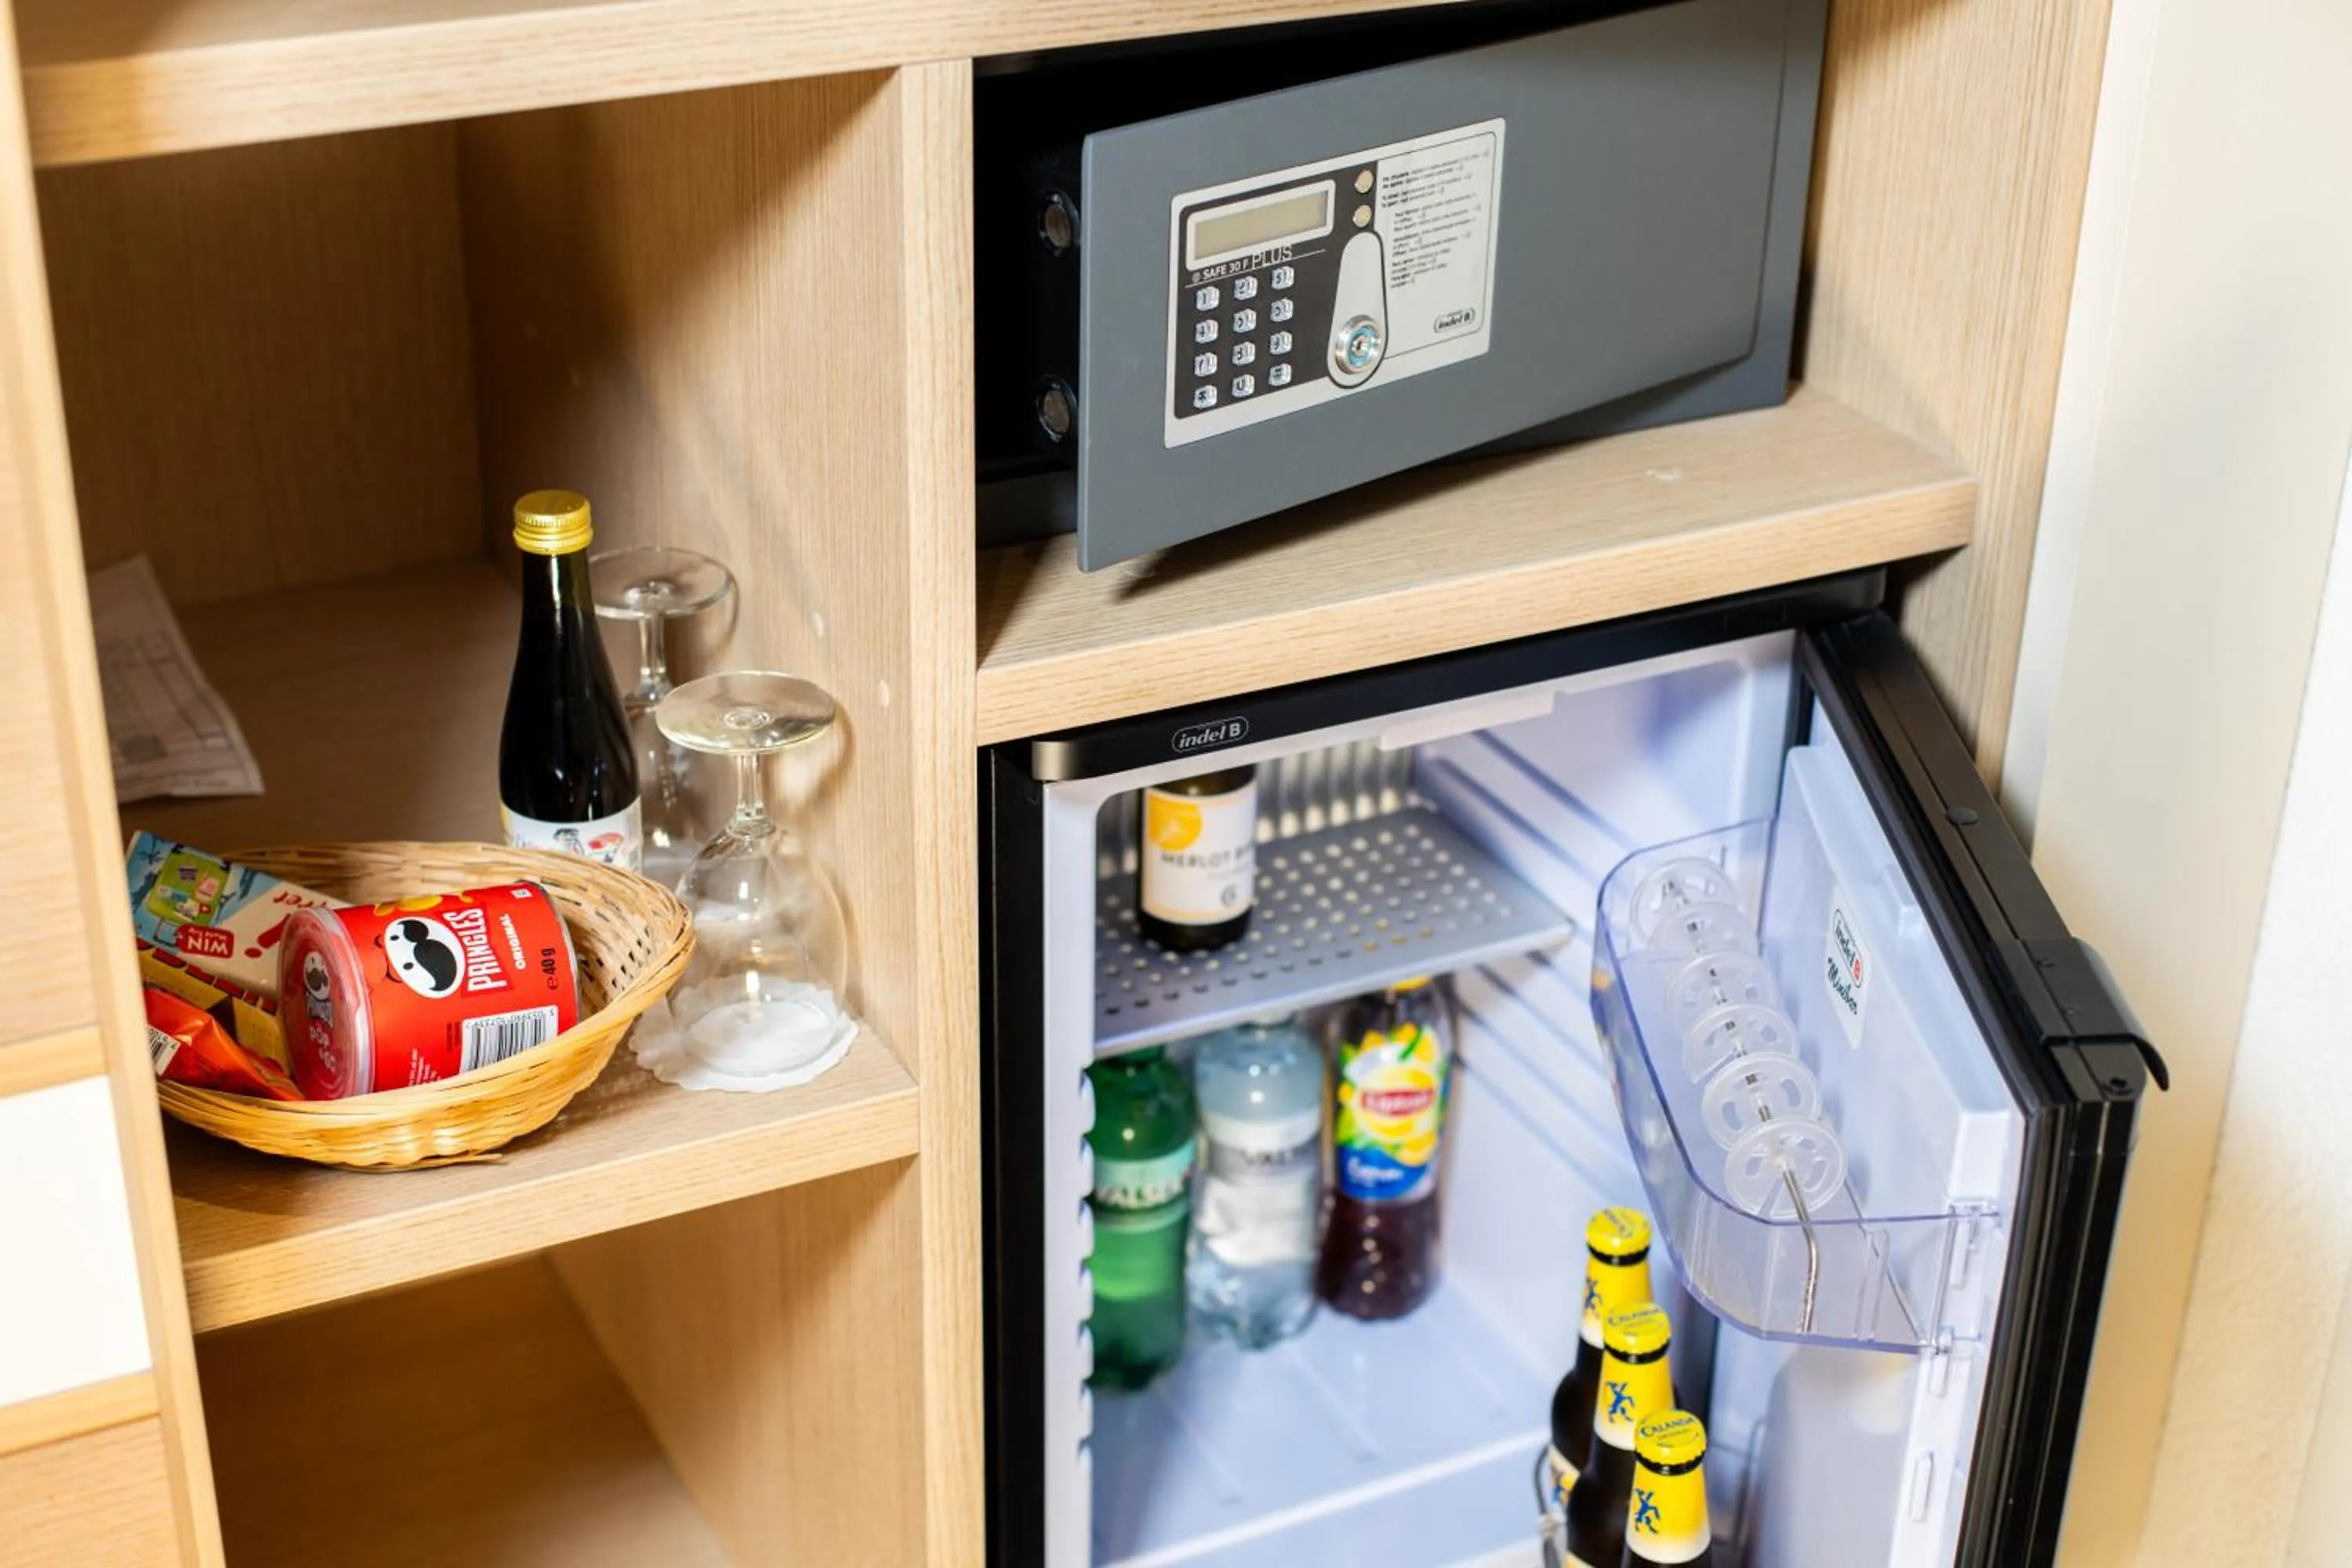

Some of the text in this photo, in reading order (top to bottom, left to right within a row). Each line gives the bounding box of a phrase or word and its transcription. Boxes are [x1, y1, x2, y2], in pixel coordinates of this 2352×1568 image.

[1203, 264, 1227, 280] SAFE
[1252, 245, 1293, 270] PLUS
[1178, 722, 1241, 749] indel B
[187, 935, 229, 956] WIN
[442, 906, 507, 992] PRINGLES
[499, 913, 527, 971] ORIGINAL
[541, 947, 556, 957] g
[1835, 919, 1856, 967] indel
[541, 958, 558, 975] 40
[1641, 1416, 1695, 1437] CALANDA
